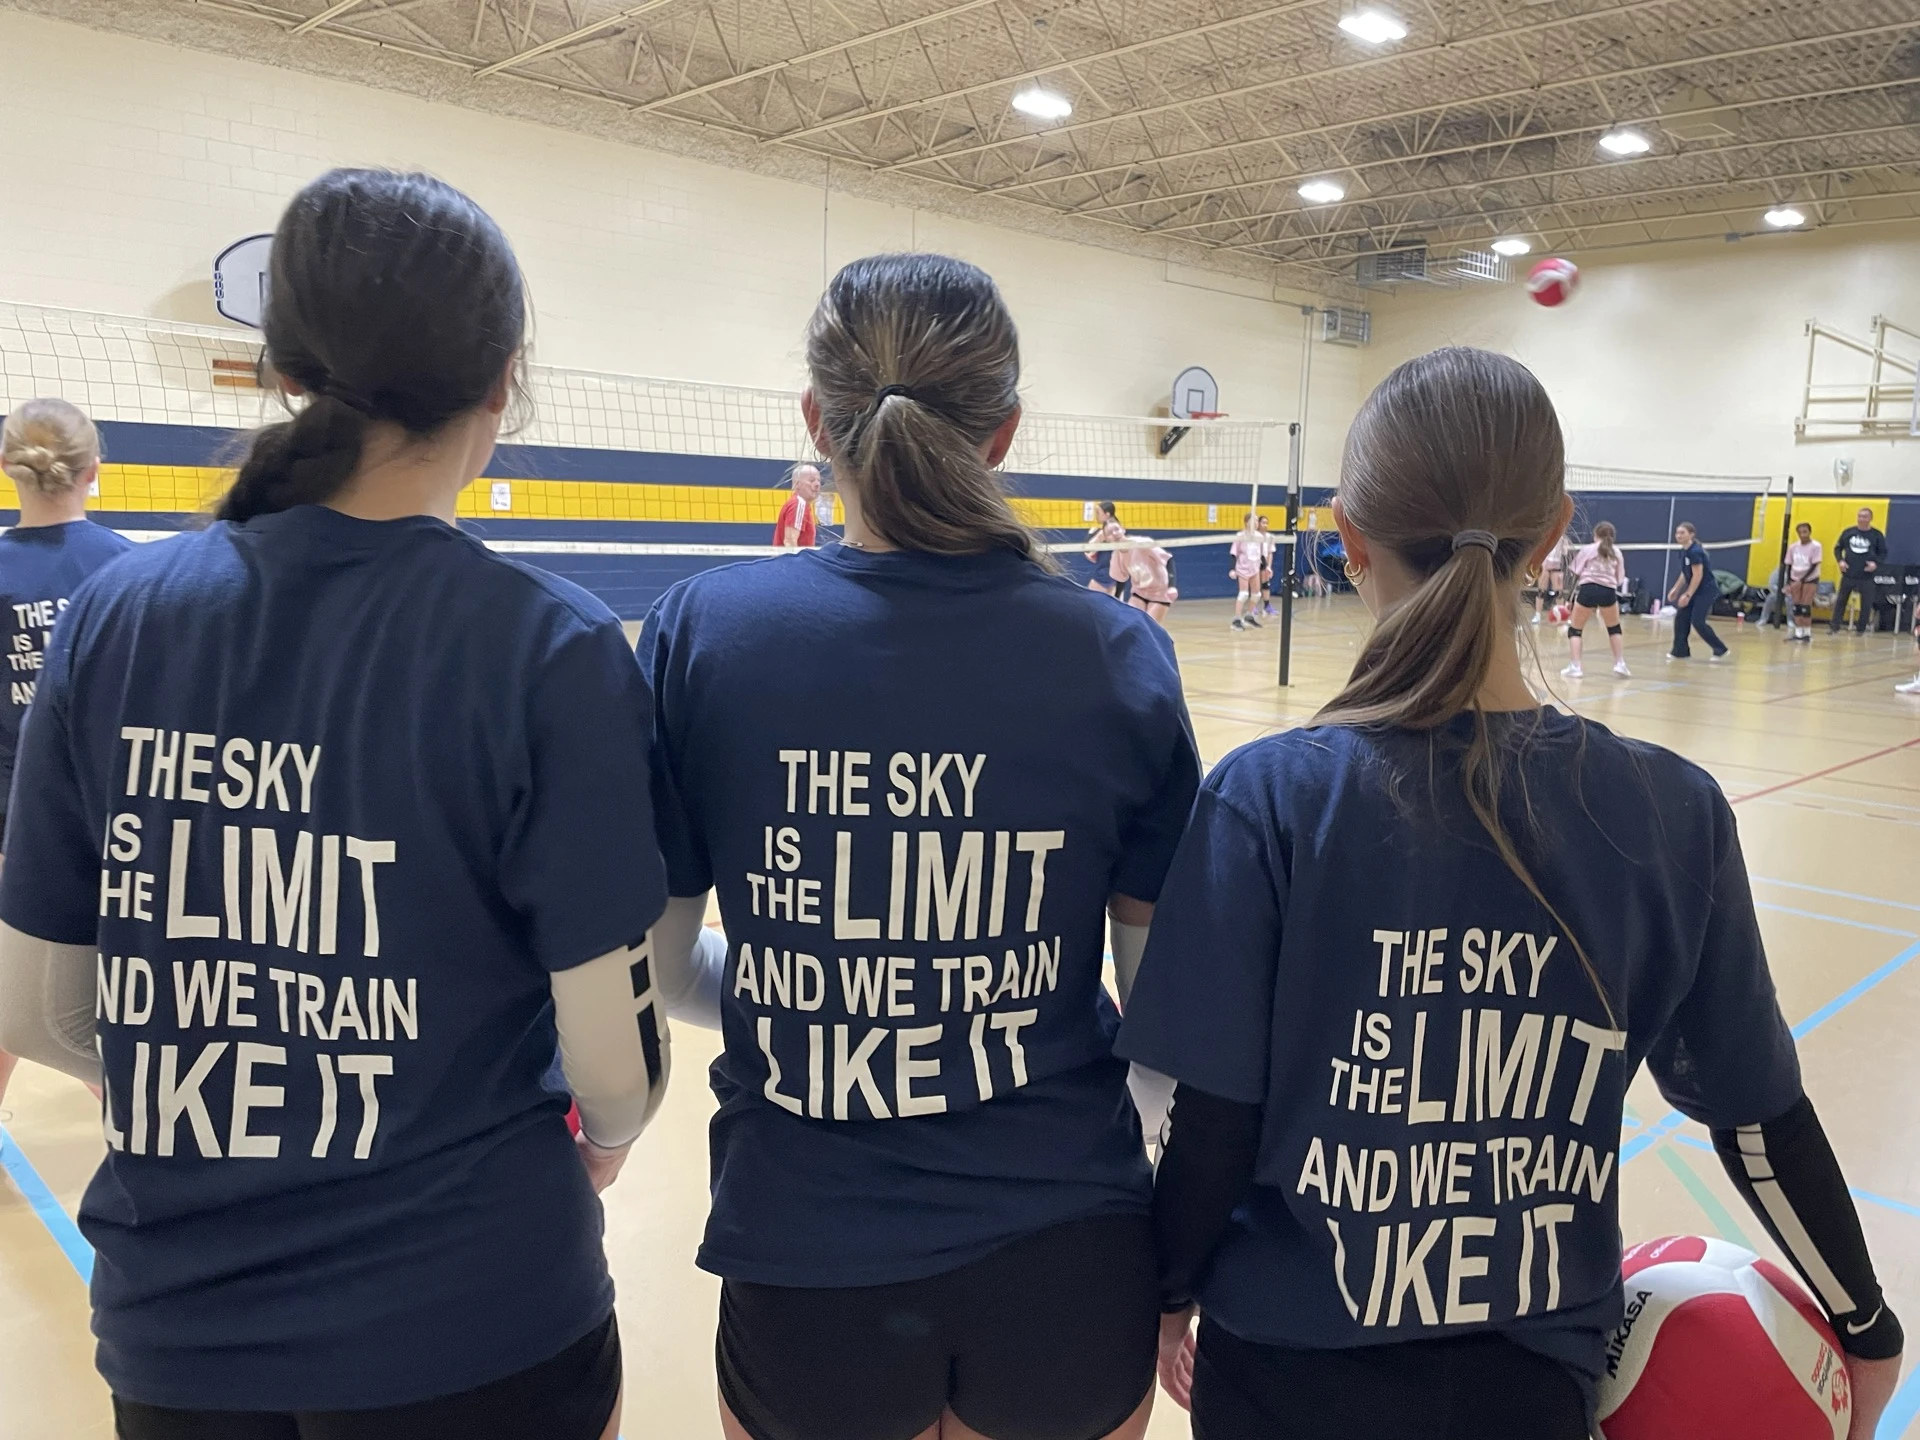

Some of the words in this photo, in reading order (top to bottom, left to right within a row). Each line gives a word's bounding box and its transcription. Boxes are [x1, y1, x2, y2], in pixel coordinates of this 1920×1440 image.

[12, 600, 56, 629] THE
[12, 633, 33, 652] IS
[6, 651, 44, 671] THE
[11, 681, 36, 705] AN
[120, 726, 216, 803] THE
[217, 738, 321, 813] SKY
[779, 750, 871, 816] THE
[886, 751, 987, 818] SKY
[764, 826, 801, 872] IS
[834, 830, 1065, 941] LIMIT
[100, 869, 155, 922] HE
[166, 819, 396, 957] LIMIT
[746, 872, 822, 924] THE
[96, 953, 155, 1025] ND
[172, 960, 258, 1029] WE
[269, 967, 418, 1040] TRAIN
[734, 943, 825, 1012] AND
[839, 957, 916, 1018] WE
[932, 936, 1061, 1013] TRAIN
[1373, 928, 1448, 998] THE
[1459, 927, 1558, 998] SKY
[757, 1016, 948, 1121] LIKE
[968, 1008, 1038, 1102] IT
[1351, 1009, 1393, 1061] IS
[1407, 1009, 1628, 1127] LIMIT
[311, 1053, 394, 1159] IT
[1329, 1057, 1405, 1114] THE
[1296, 1137, 1400, 1213] AND
[1410, 1142, 1477, 1208] WE
[1486, 1135, 1615, 1205] TRAIN
[1515, 1203, 1575, 1317] IT
[1606, 1291, 1653, 1380] MIKASA
